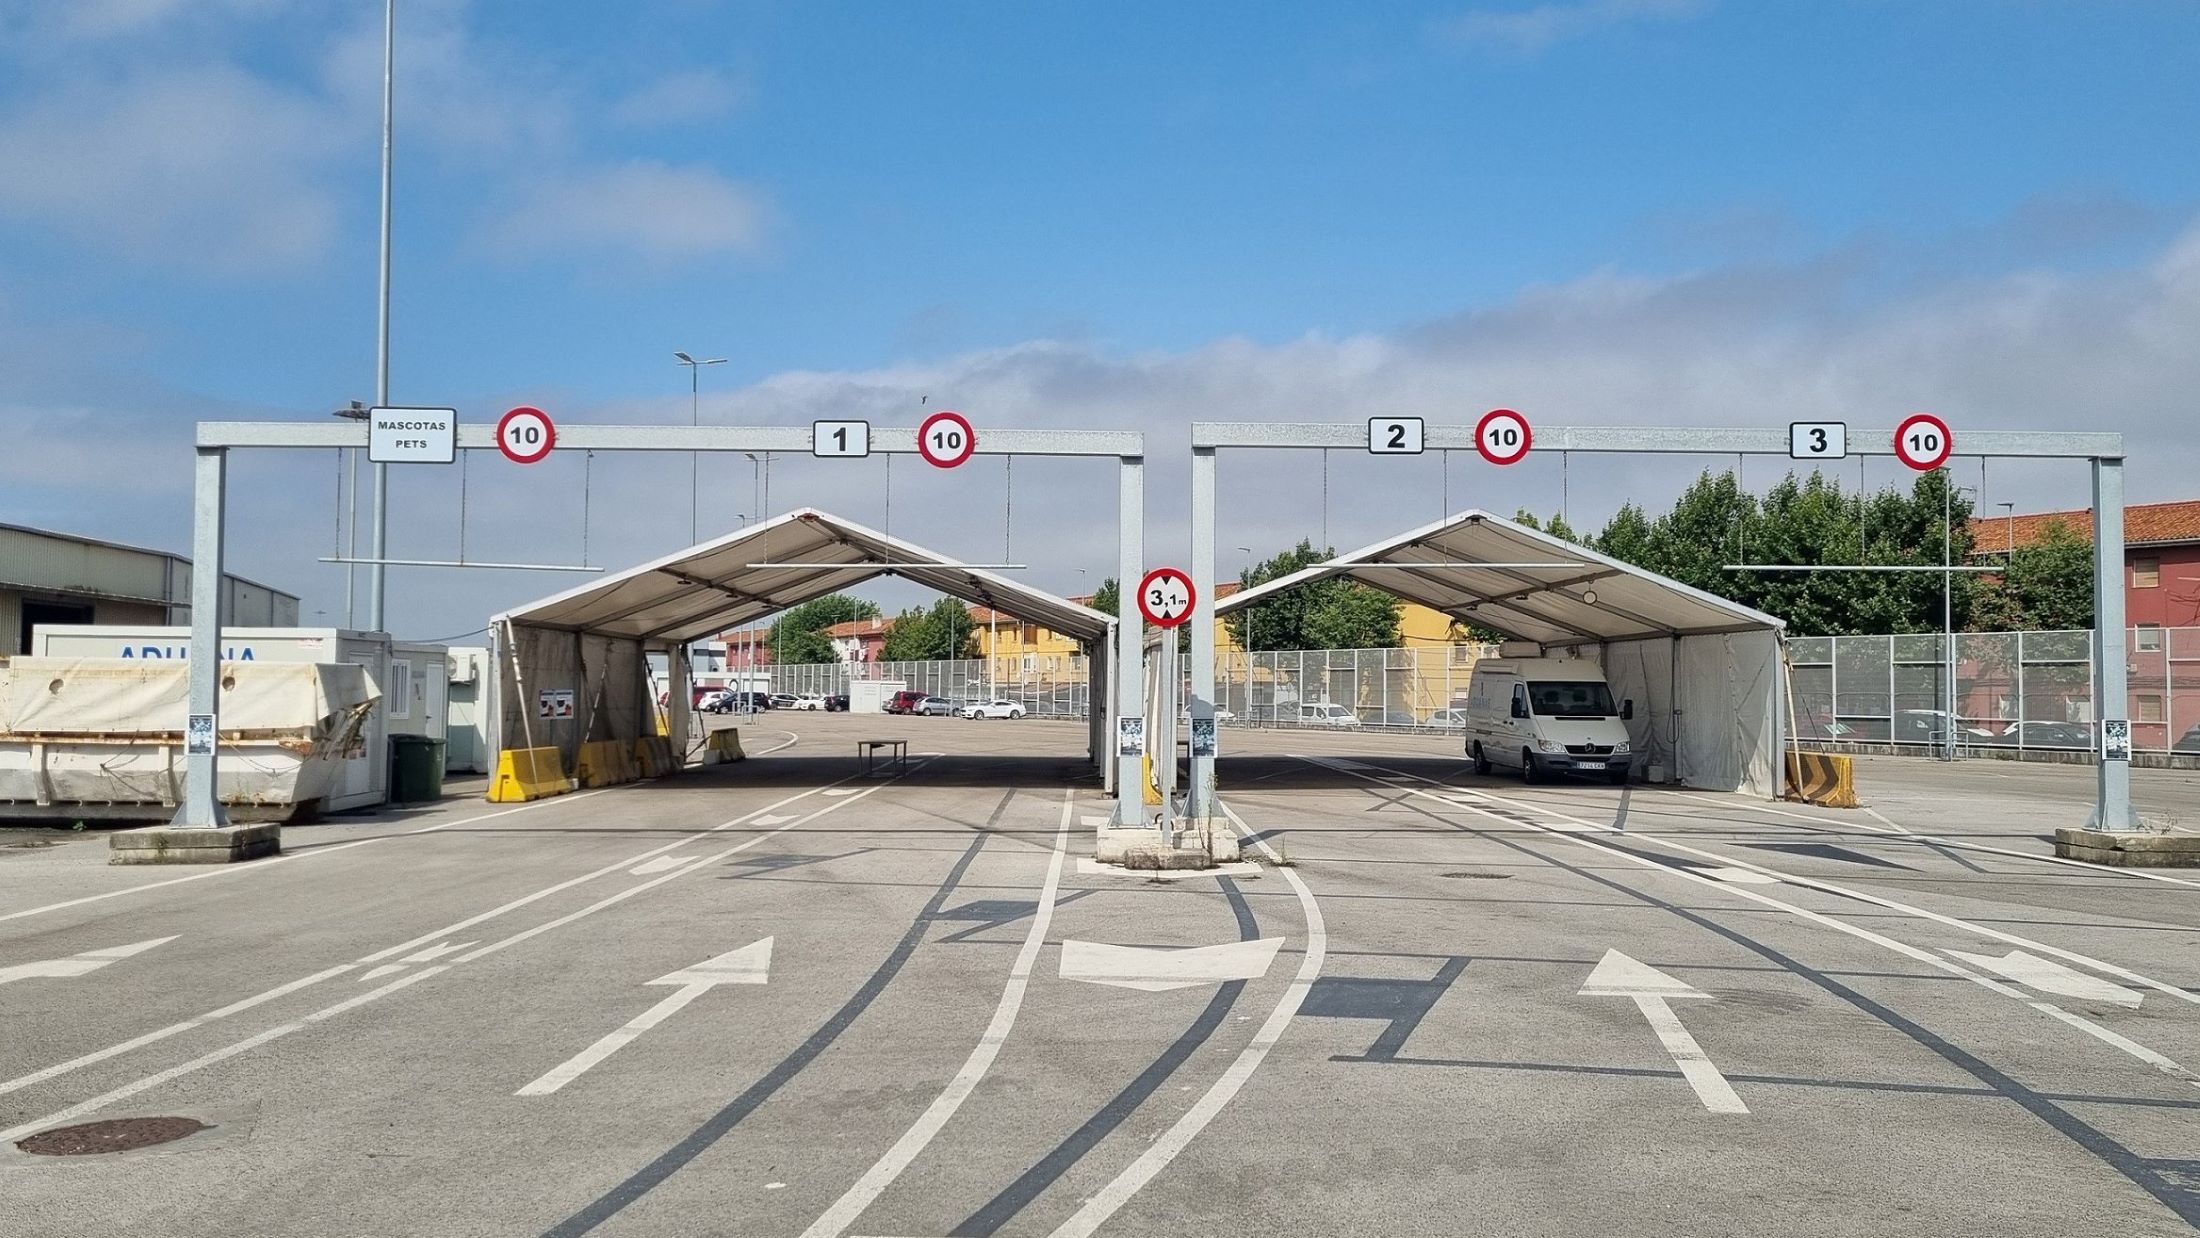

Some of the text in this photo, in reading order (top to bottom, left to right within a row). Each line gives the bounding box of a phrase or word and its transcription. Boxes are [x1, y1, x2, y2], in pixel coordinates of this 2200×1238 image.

[377, 421, 446, 431] MASCOTAS
[395, 440, 427, 448] PETS
[510, 427, 539, 444] 10
[832, 427, 847, 452] 1
[932, 431, 961, 449] 10
[1387, 424, 1406, 449] 2
[1488, 429, 1518, 446] 10
[1809, 428, 1828, 453] 3
[1909, 434, 1938, 451] 10
